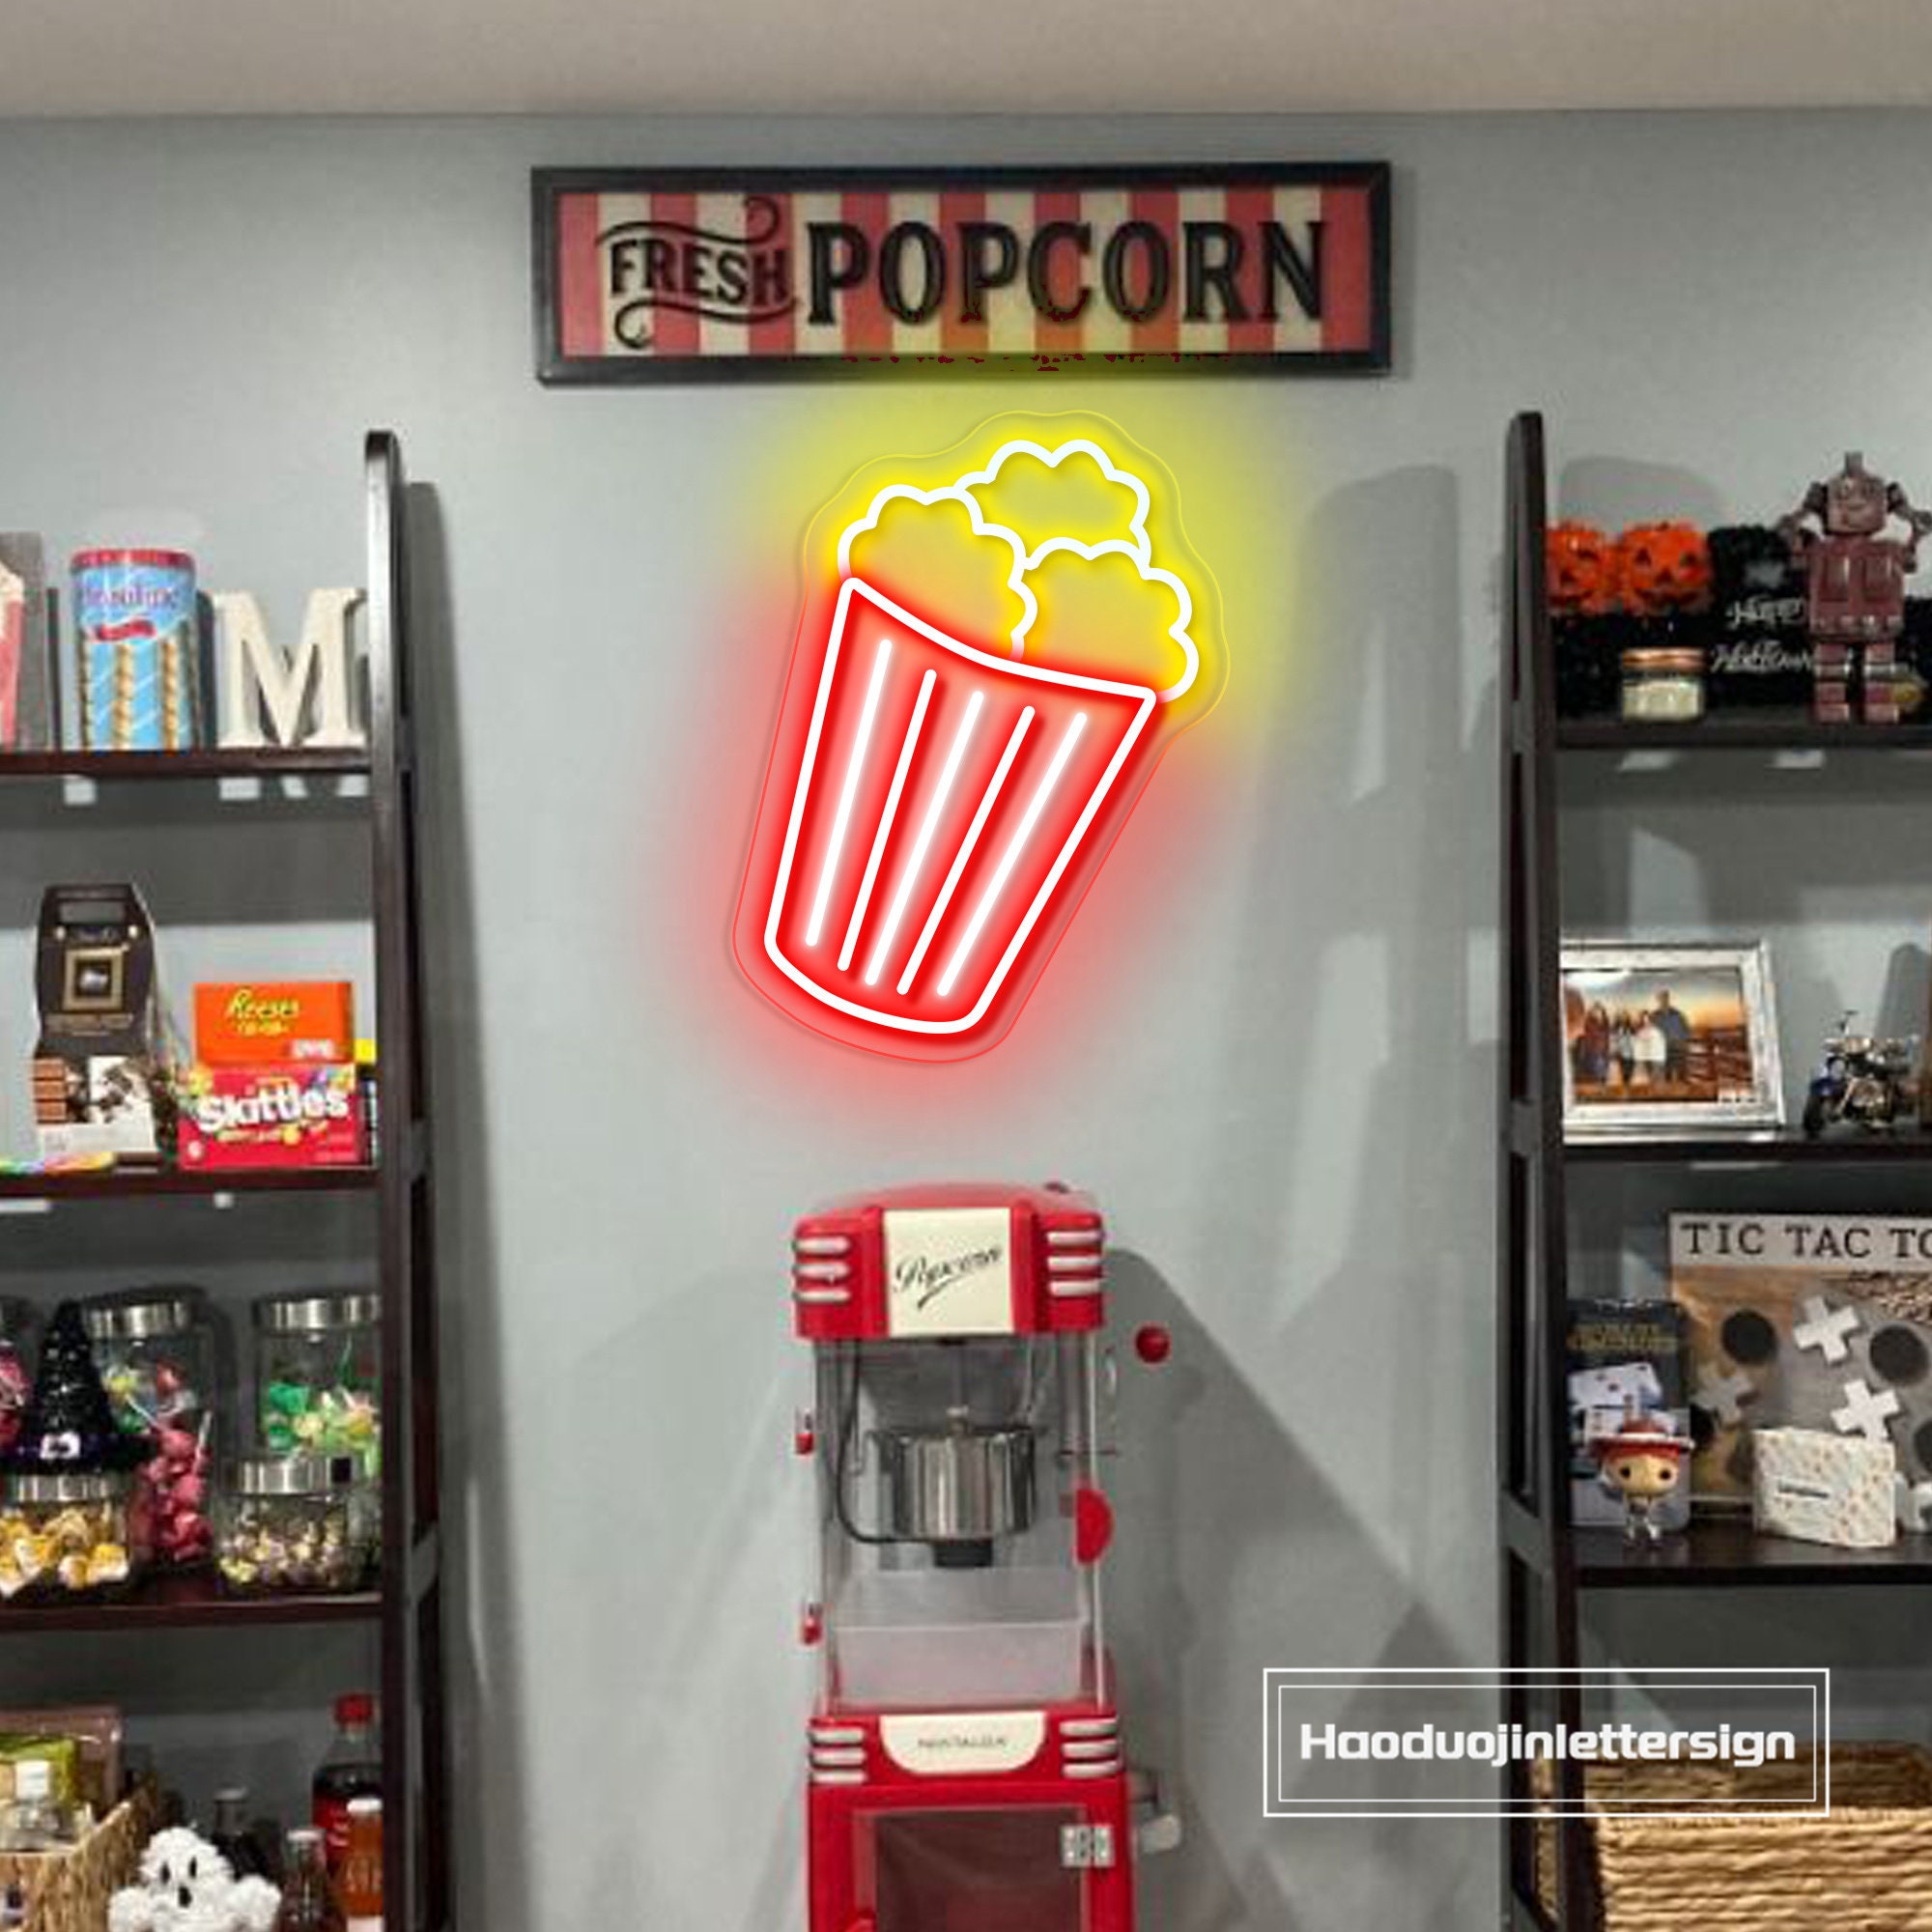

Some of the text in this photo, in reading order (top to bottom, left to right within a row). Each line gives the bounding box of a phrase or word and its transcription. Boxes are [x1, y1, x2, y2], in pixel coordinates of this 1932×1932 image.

[611, 220, 1329, 326] FRESH POPCORN
[213, 586, 368, 750] M
[1680, 1222, 1765, 1255] TIC
[1784, 1226, 1872, 1258] TAC
